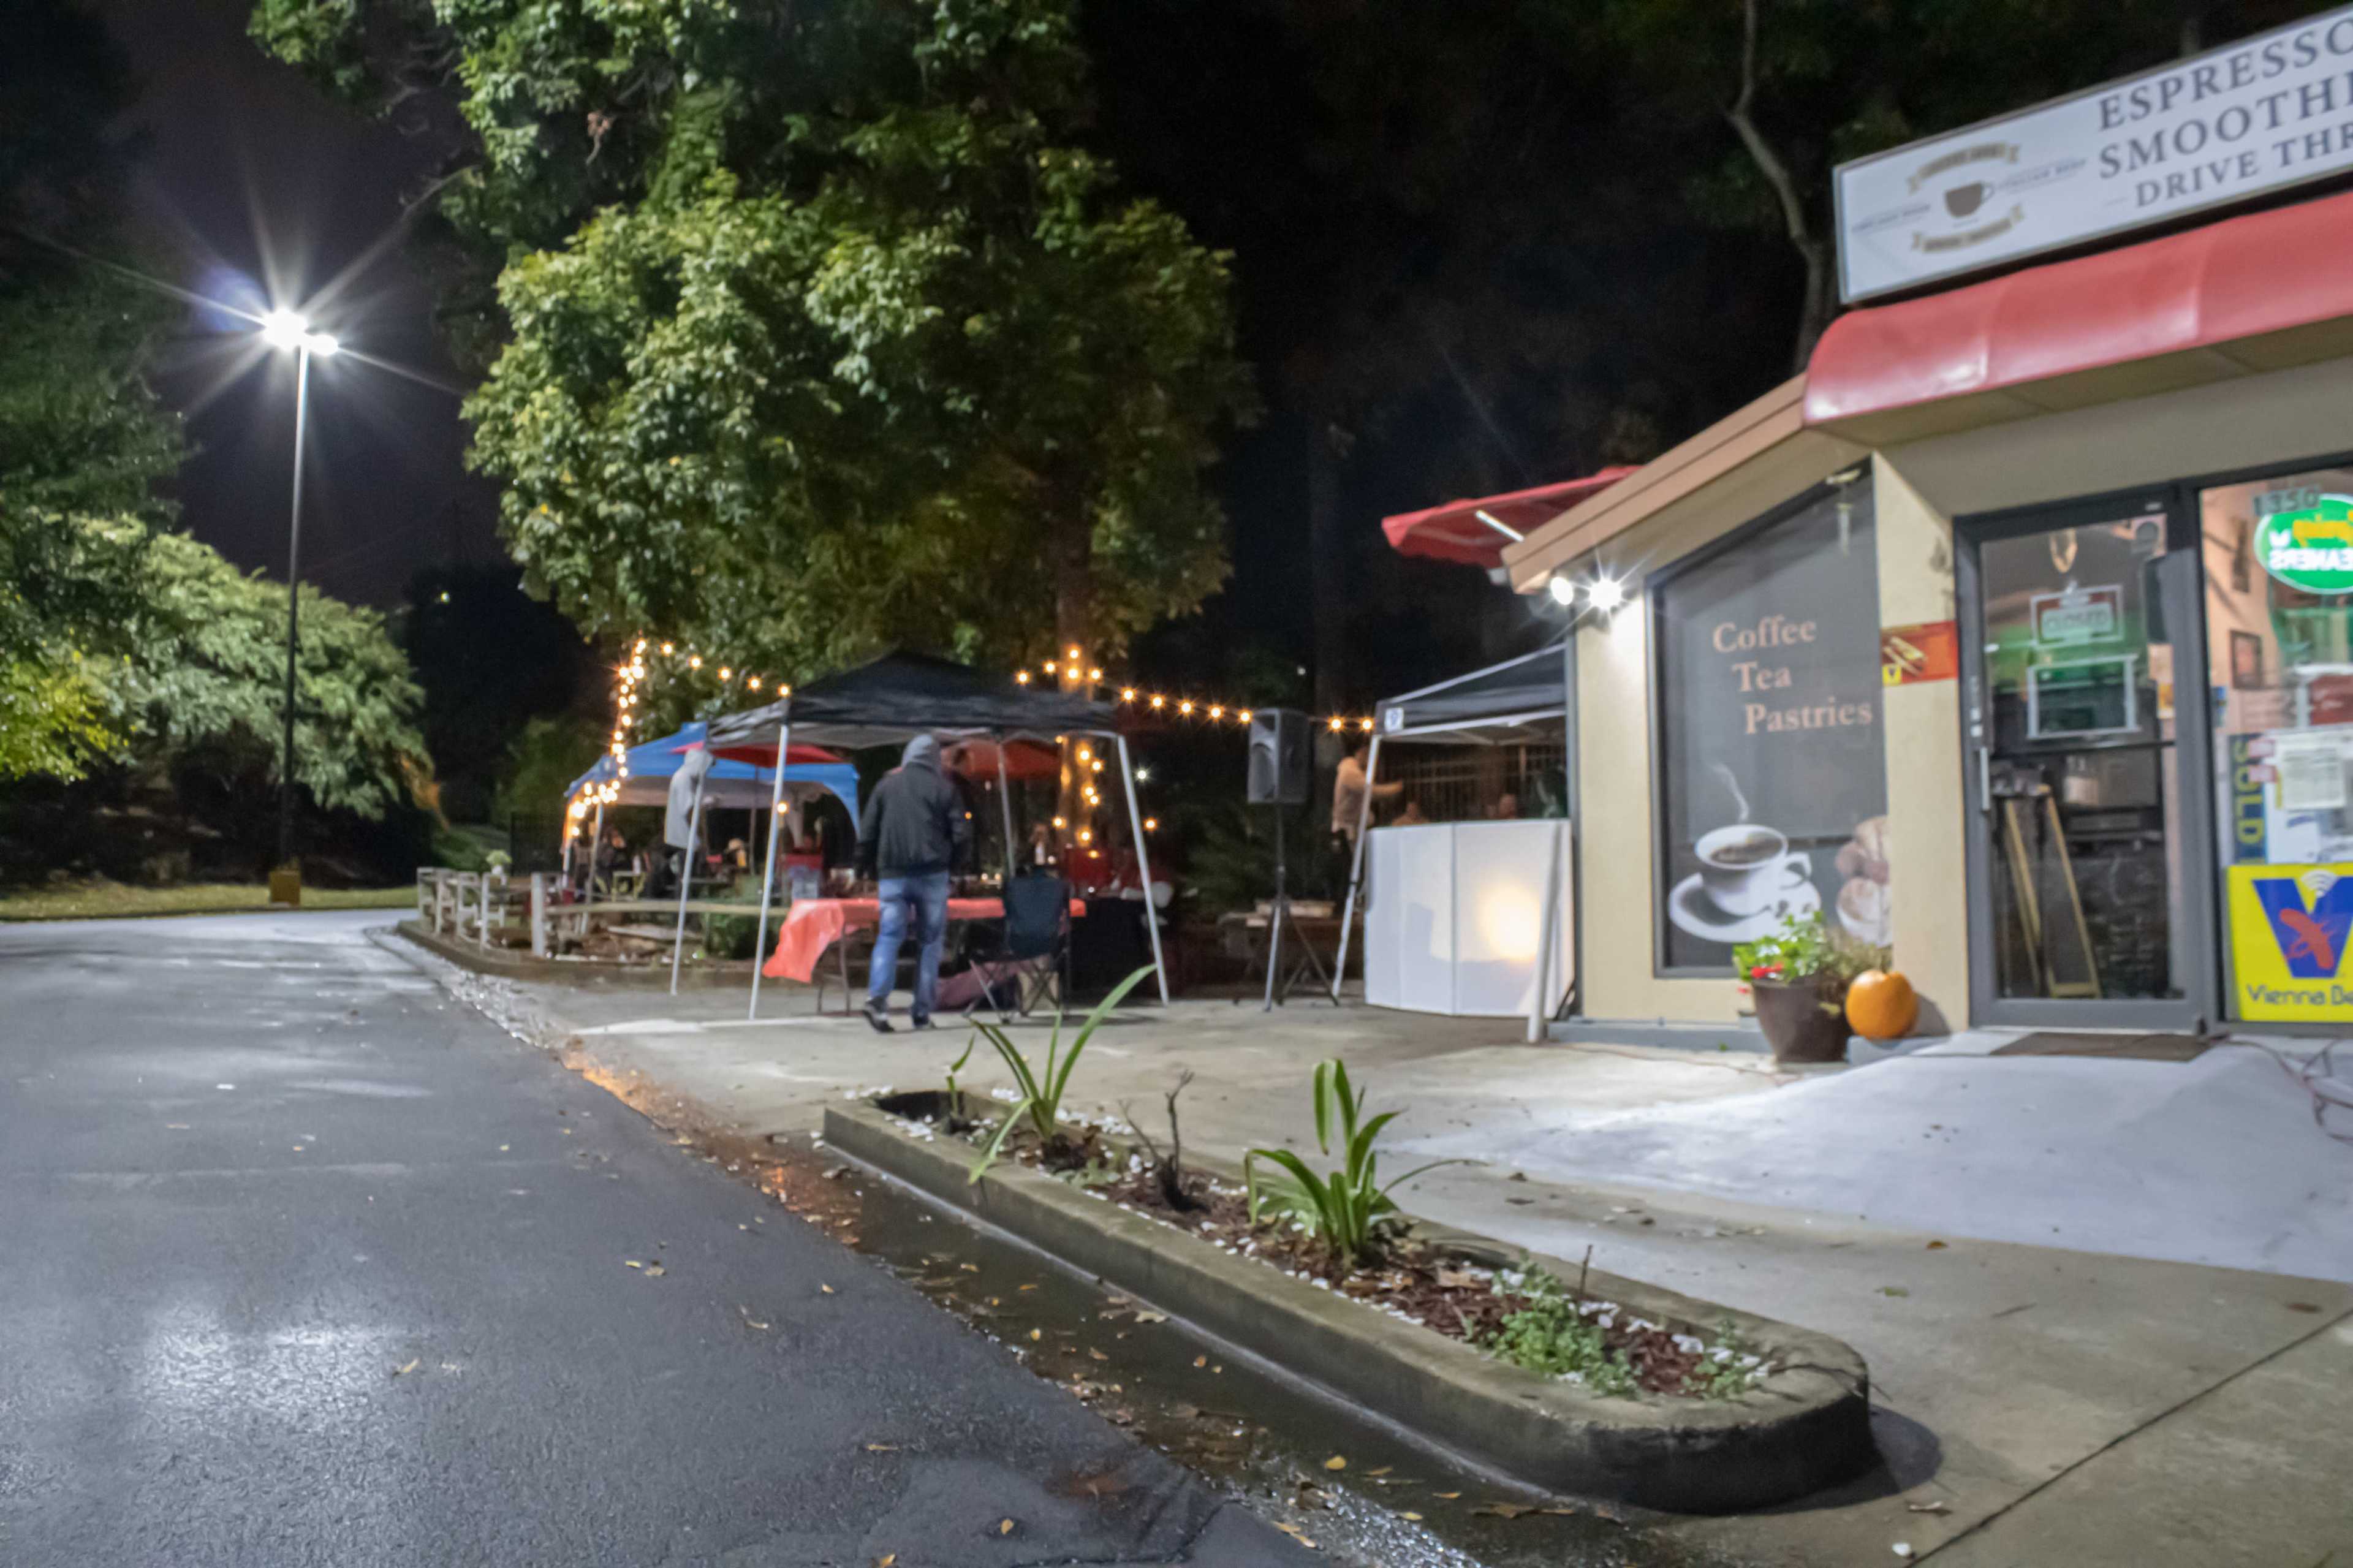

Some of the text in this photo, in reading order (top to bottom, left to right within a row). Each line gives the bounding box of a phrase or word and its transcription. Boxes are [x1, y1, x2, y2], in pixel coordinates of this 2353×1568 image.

[2135, 150, 2260, 208] DRIVE
[1713, 614, 1817, 653] Coffee
[1731, 660, 1792, 692] Tea
[1745, 695, 1873, 735] Pastries
[2247, 984, 2325, 1006] Vienna
